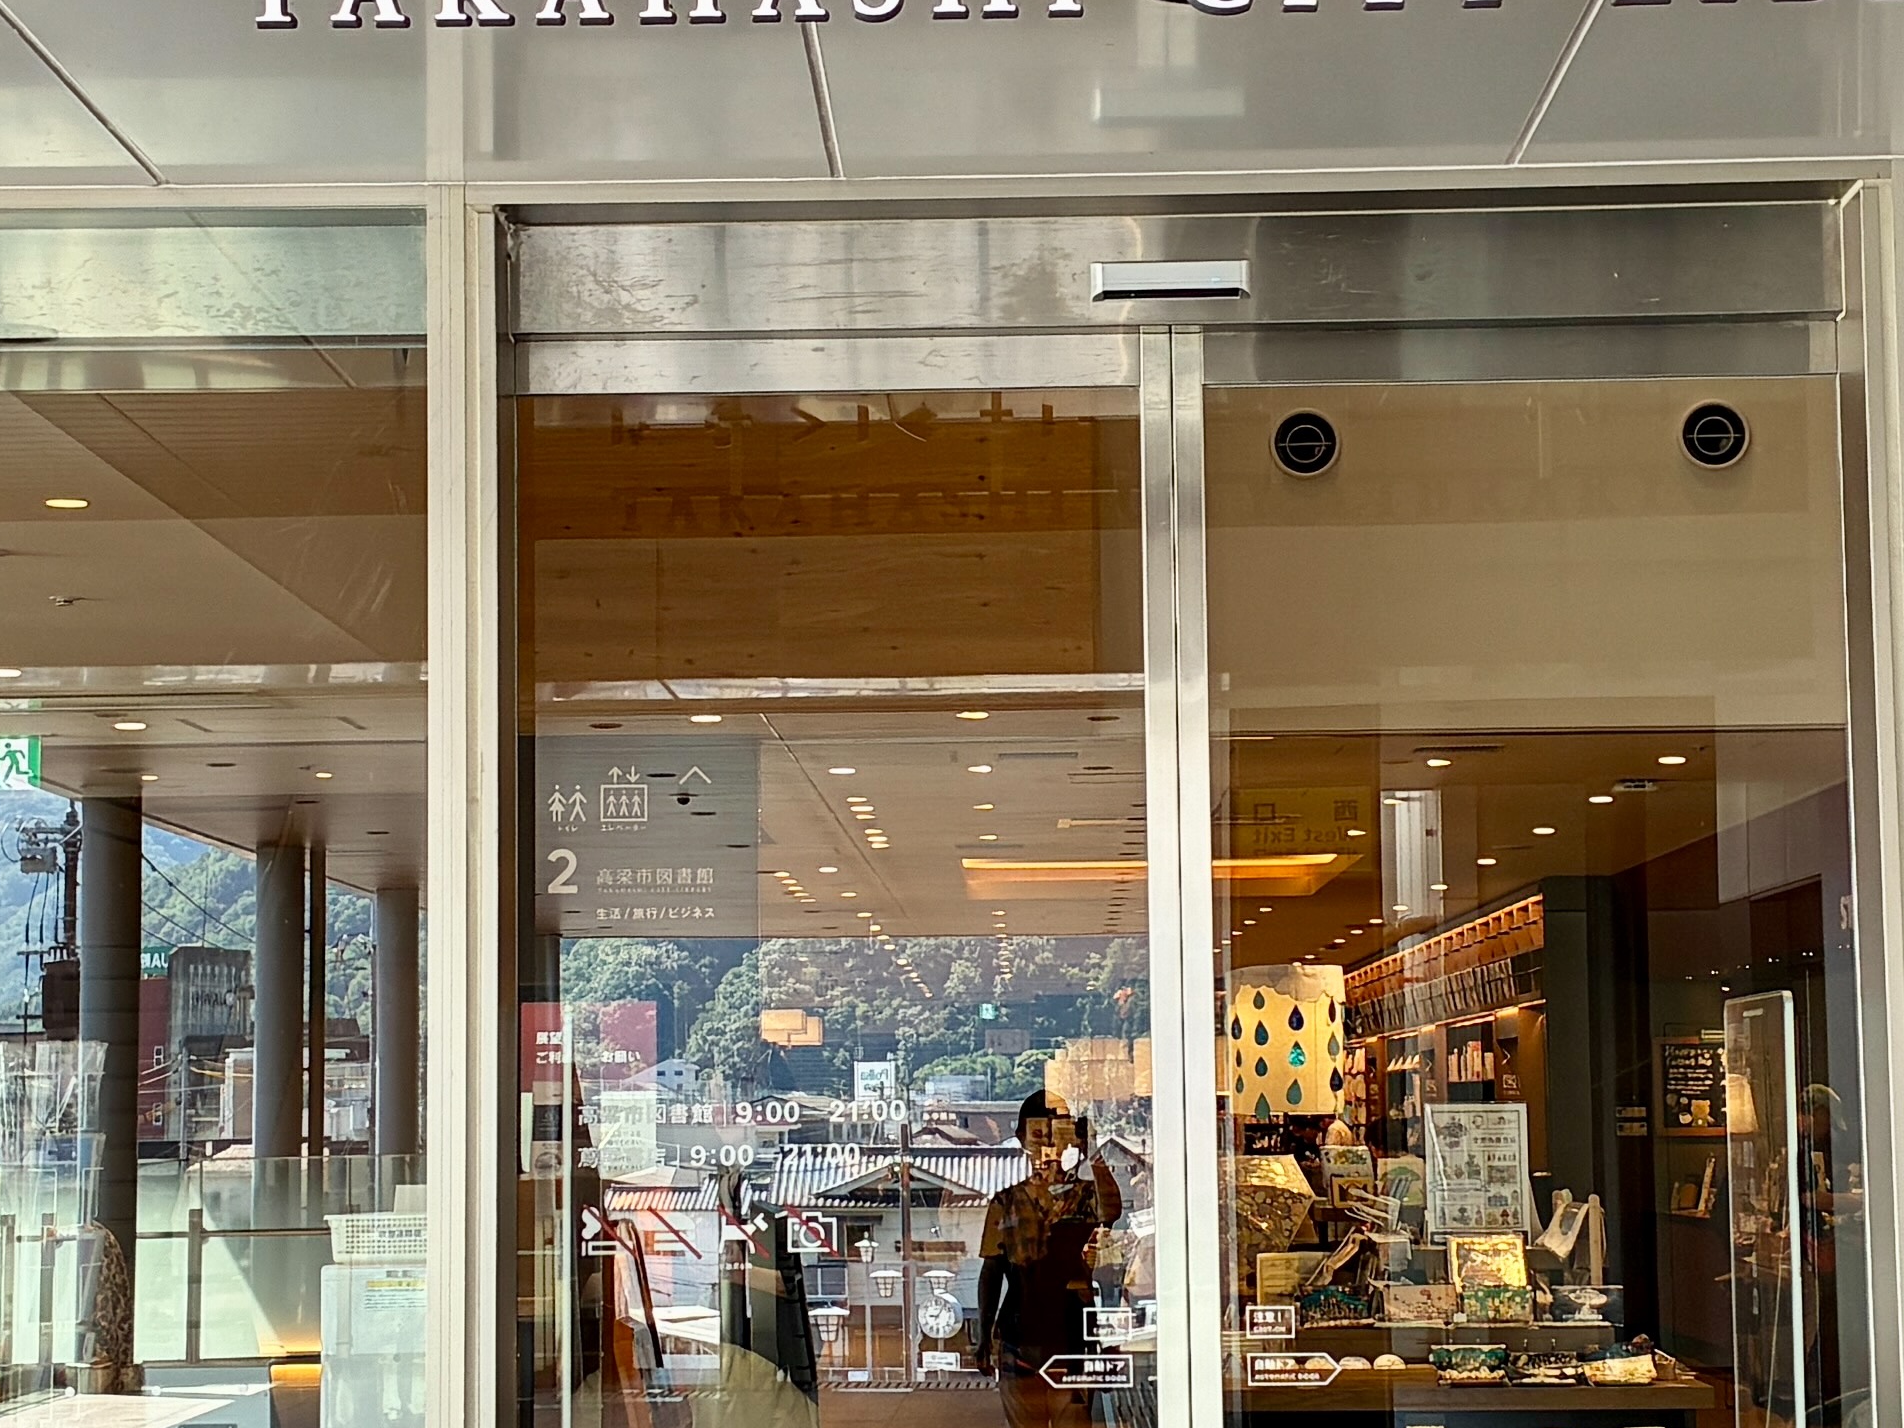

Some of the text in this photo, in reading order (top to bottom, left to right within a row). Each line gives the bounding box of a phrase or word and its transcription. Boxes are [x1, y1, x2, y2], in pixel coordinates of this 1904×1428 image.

[547, 848, 578, 894] 2
[596, 868, 714, 885] 高梁市図書館
[736, 1100, 907, 1122] 9:00 21:00
[690, 1144, 754, 1166] 9:00
[1084, 1361, 1125, 1372] 自動ドア
